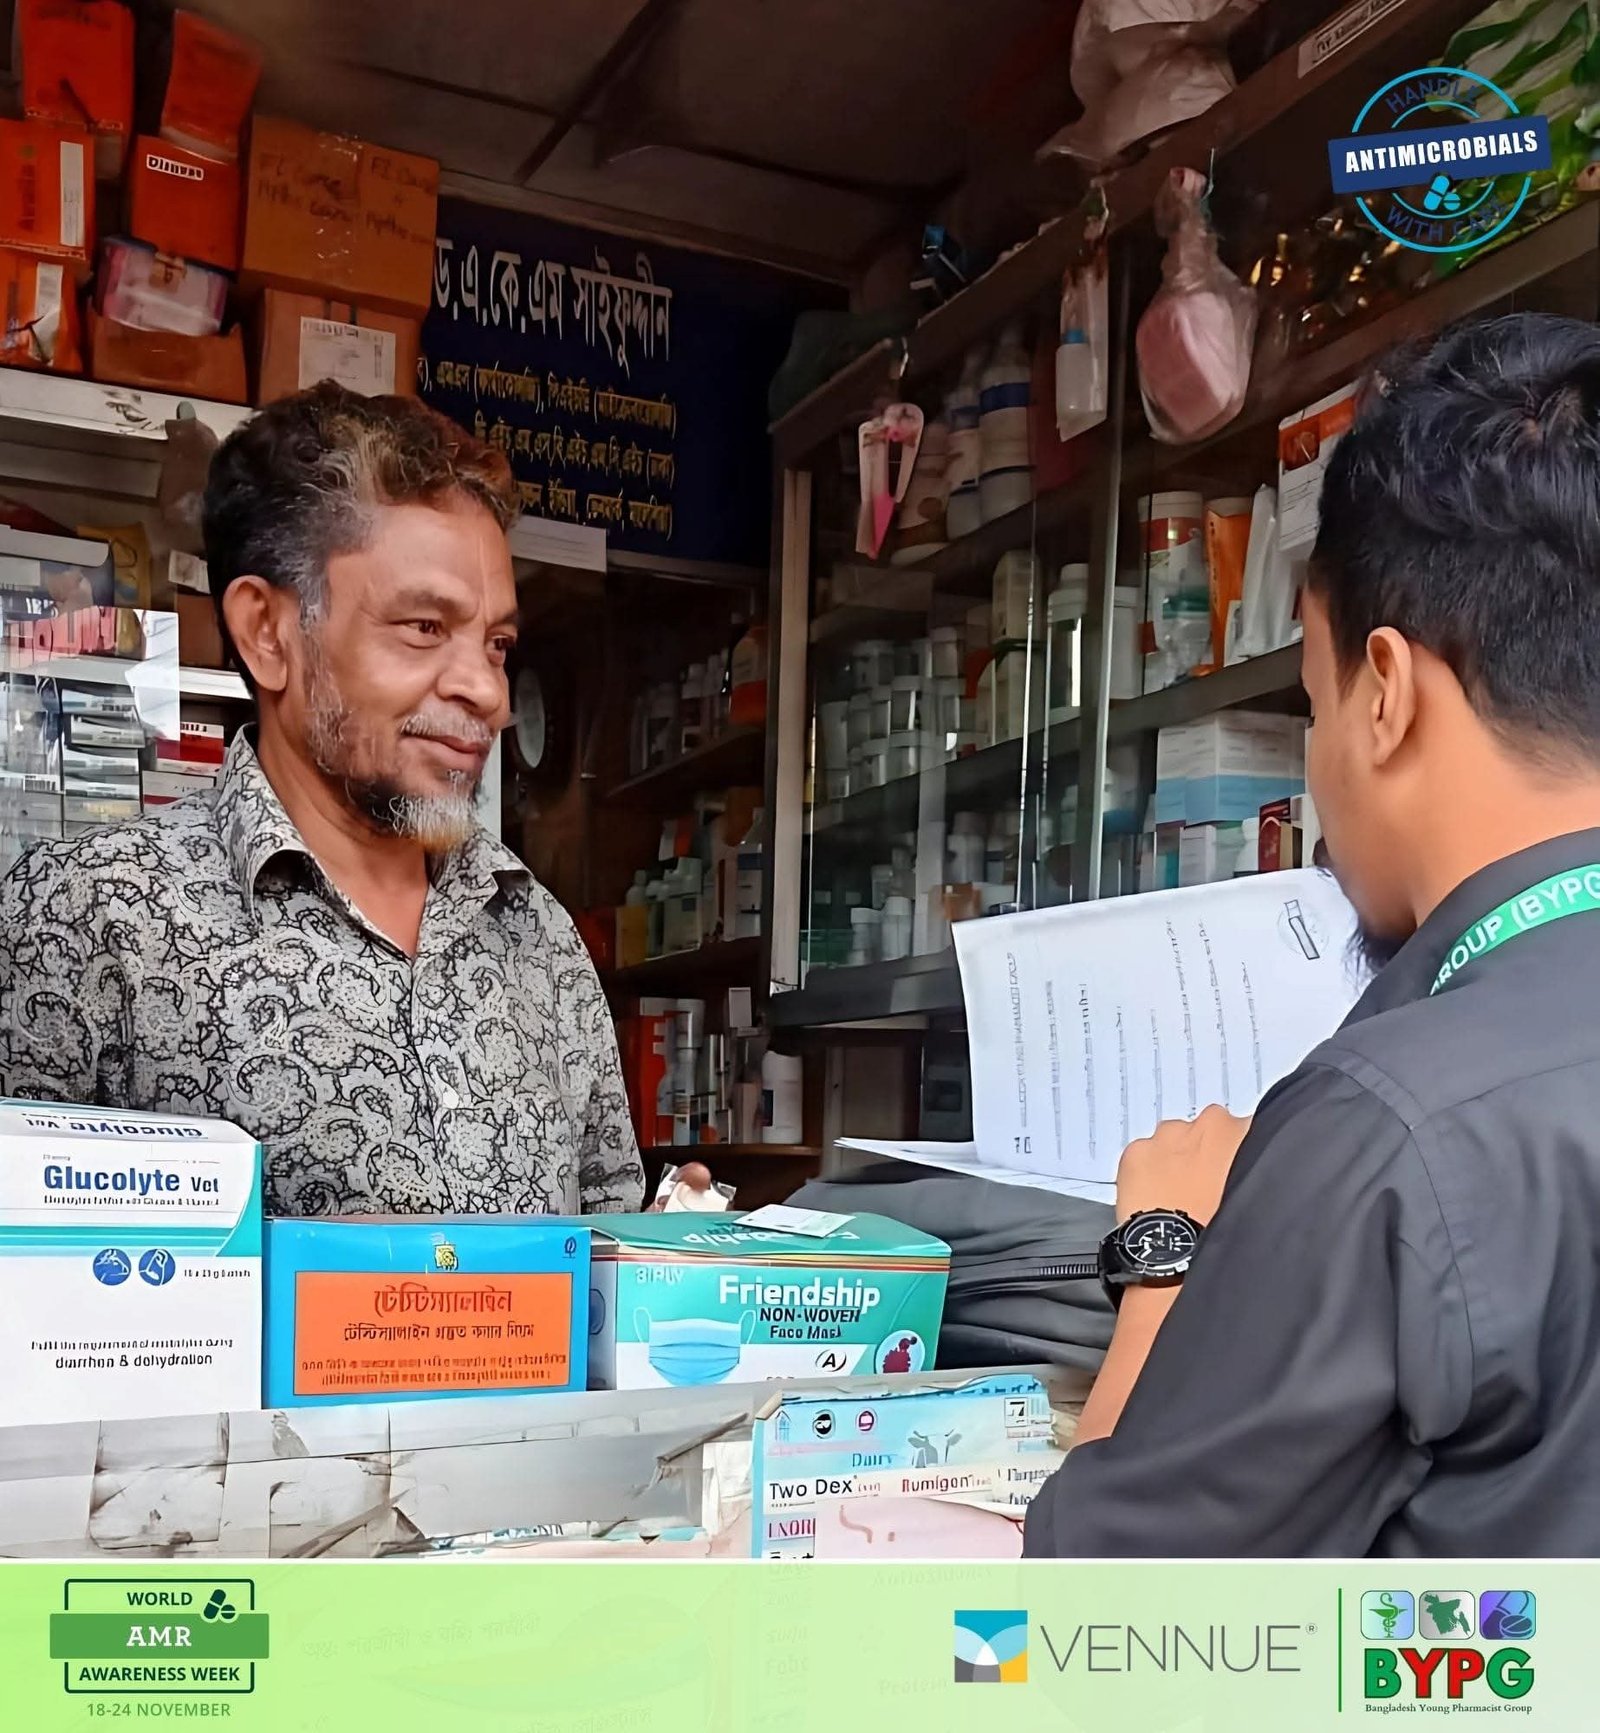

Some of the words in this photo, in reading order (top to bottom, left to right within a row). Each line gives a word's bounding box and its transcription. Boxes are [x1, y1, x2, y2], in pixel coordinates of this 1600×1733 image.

[44, 1165, 181, 1196] Glucolyte
[719, 1274, 881, 1315] Friendship
[770, 1482, 807, 1500] Two
